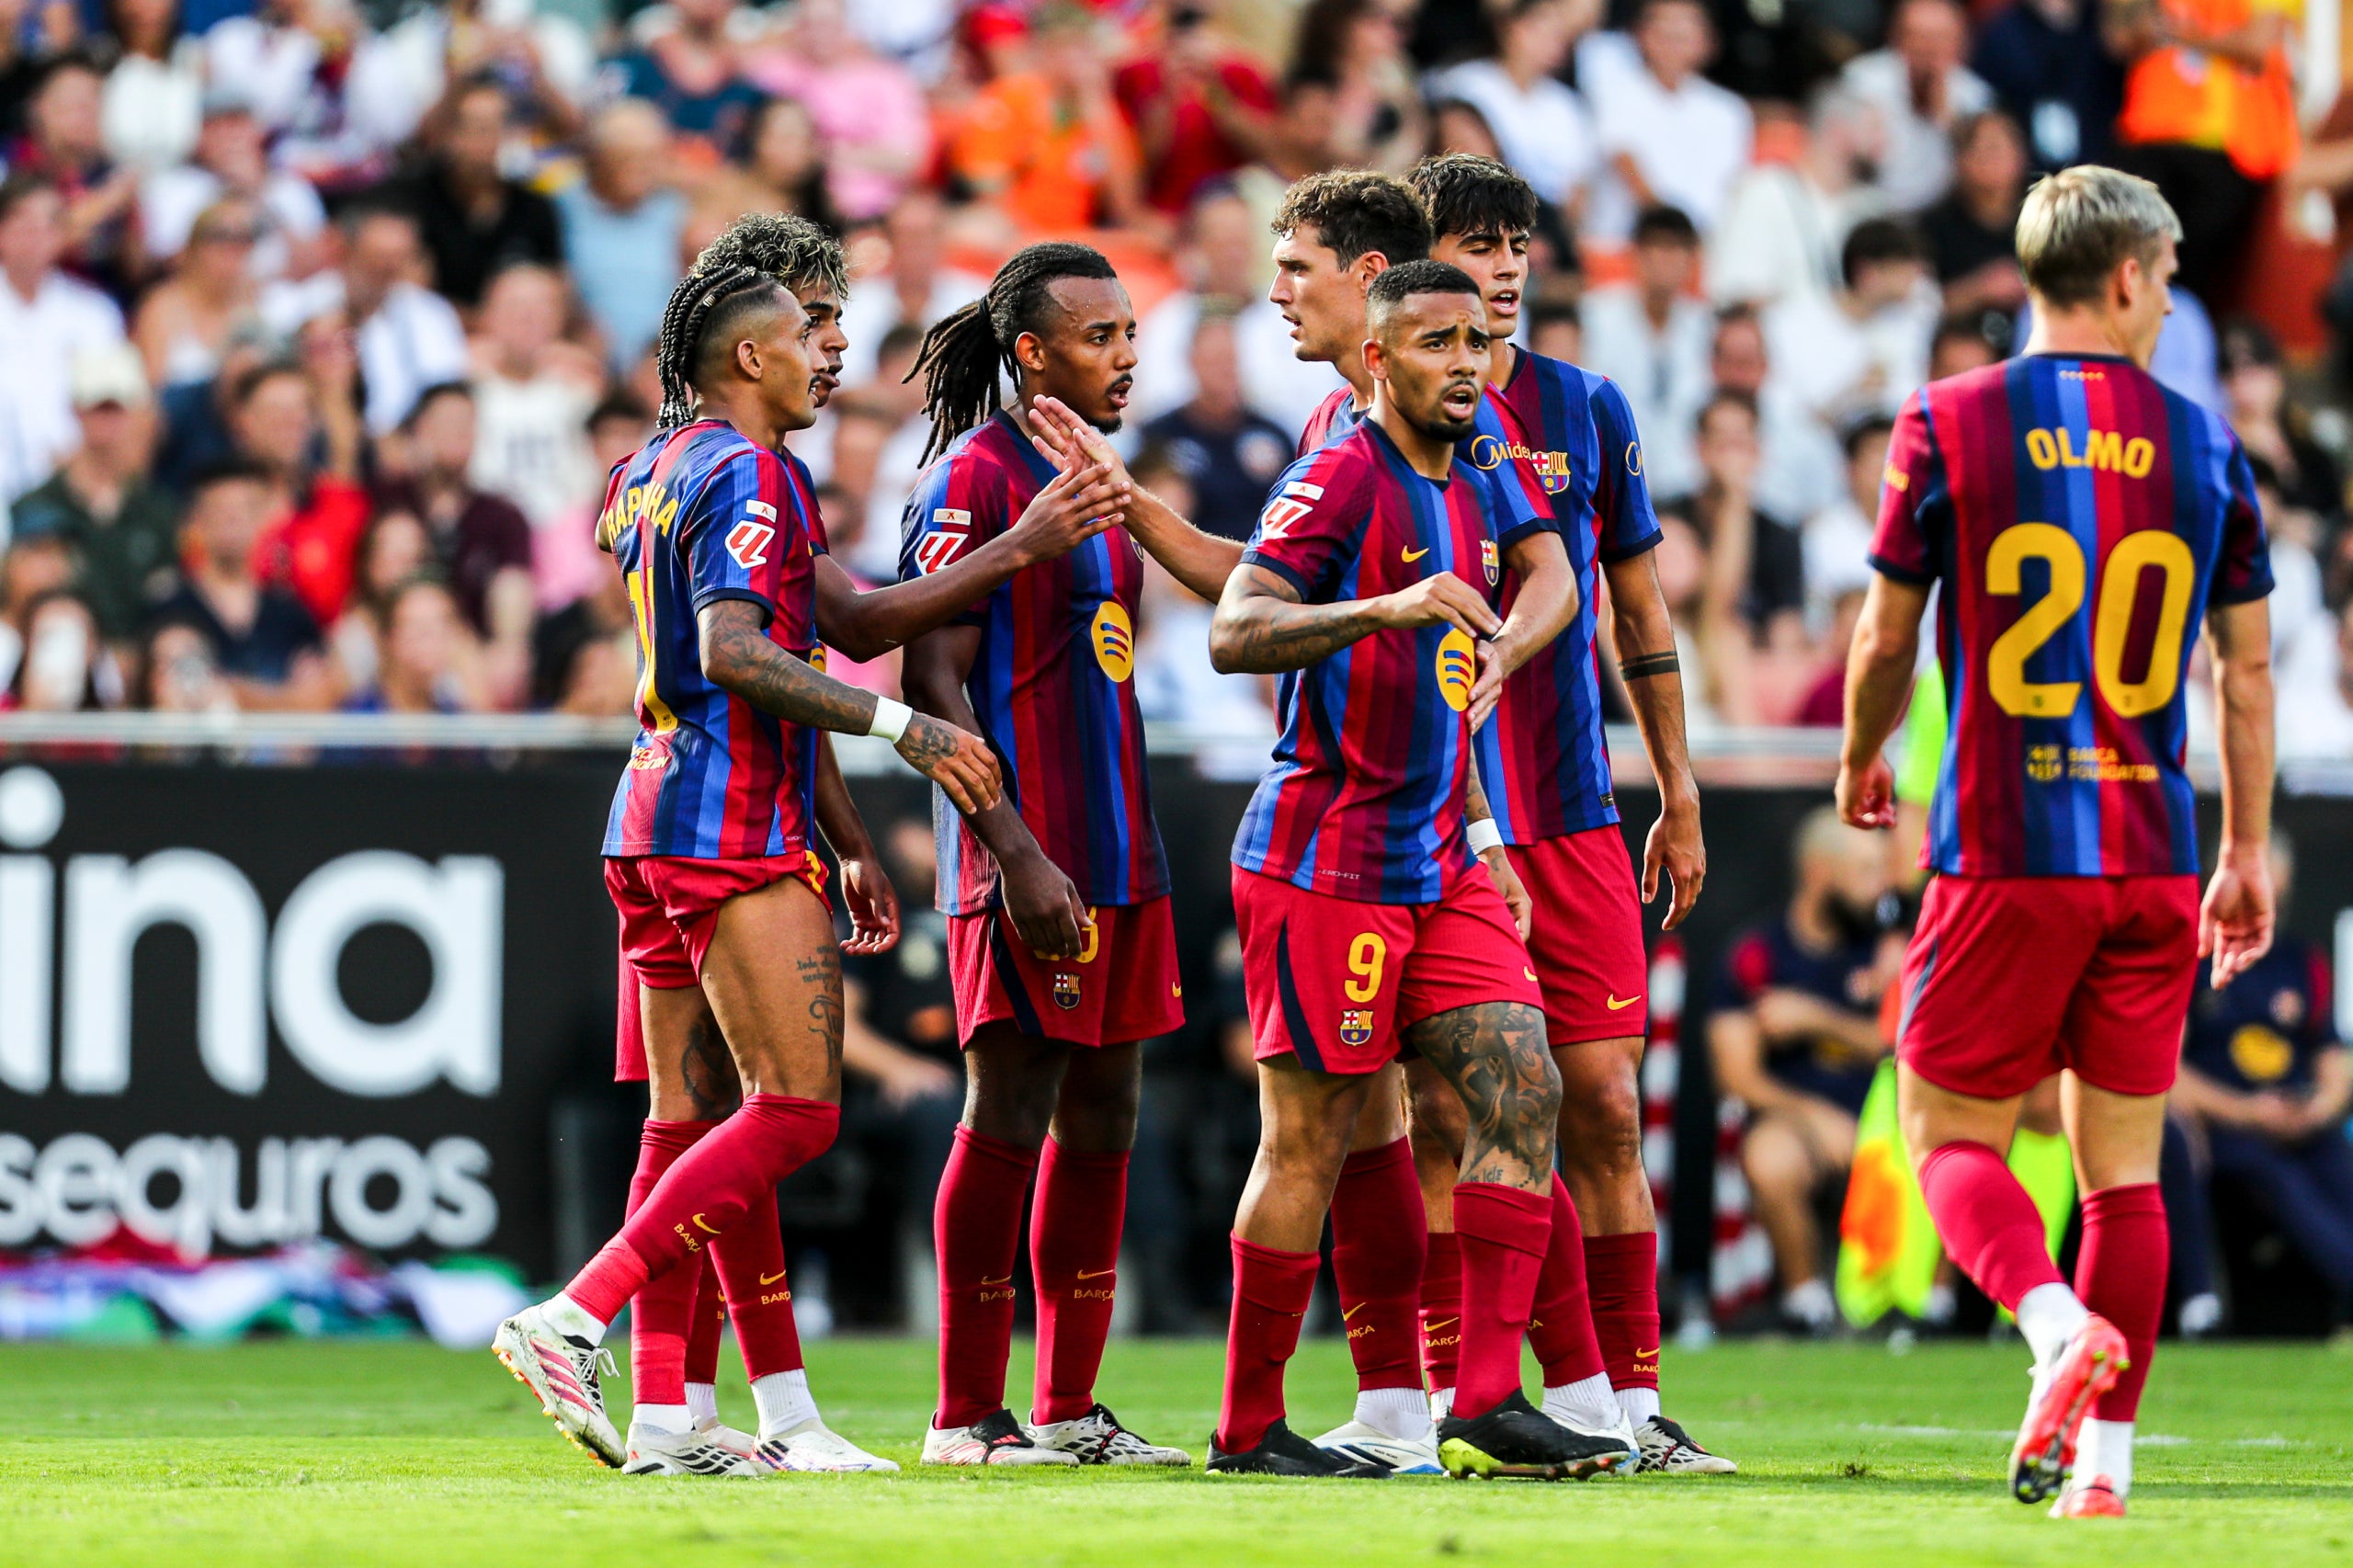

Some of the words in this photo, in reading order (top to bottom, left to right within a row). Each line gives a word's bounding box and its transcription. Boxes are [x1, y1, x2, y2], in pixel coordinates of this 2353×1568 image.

[2026, 427, 2155, 478] OLMO
[1985, 522, 2195, 718] 20
[0, 765, 506, 1097] ina
[1344, 932, 1387, 1004] 9
